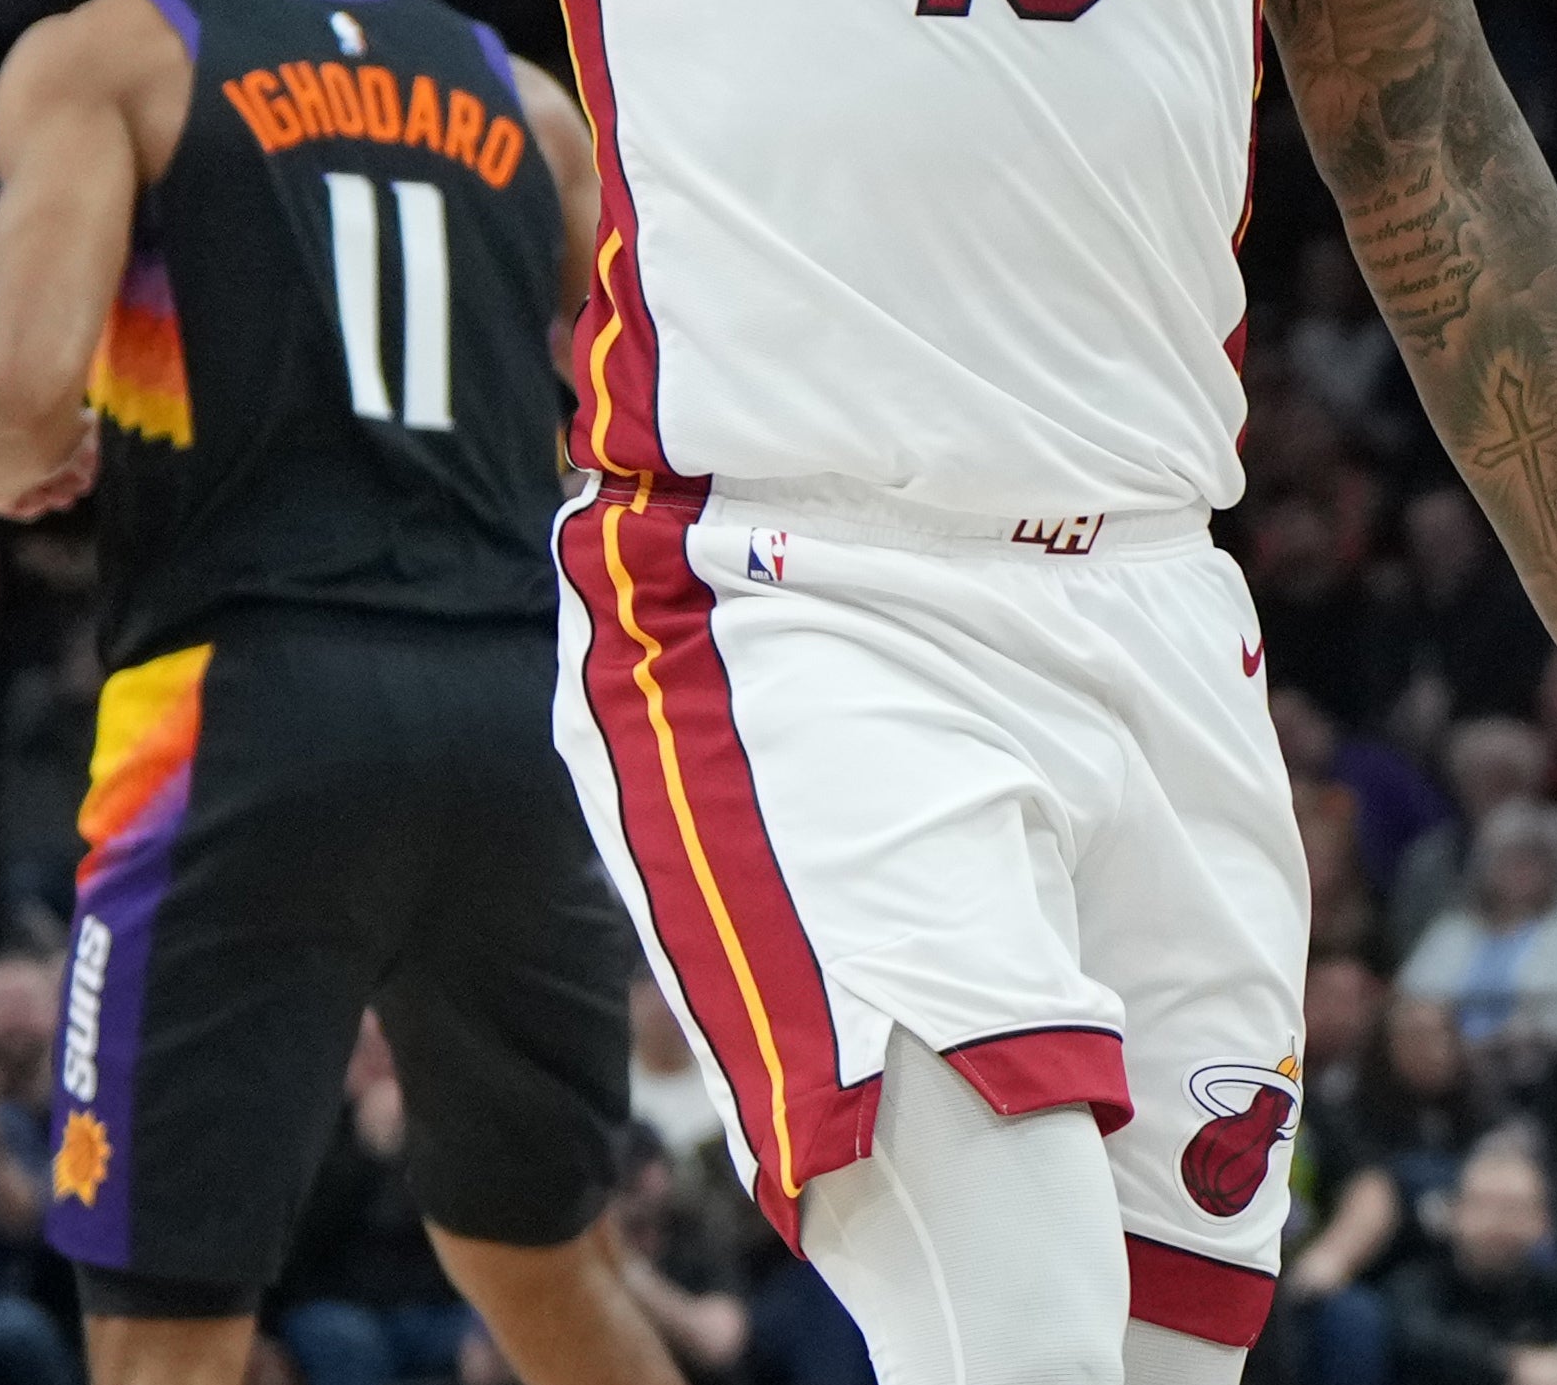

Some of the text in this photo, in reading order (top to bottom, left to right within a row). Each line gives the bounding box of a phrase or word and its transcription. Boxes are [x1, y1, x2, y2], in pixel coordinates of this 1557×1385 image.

[223, 61, 524, 189] IGHODARO
[324, 171, 454, 431] 11
[63, 914, 112, 1103] SUNS
